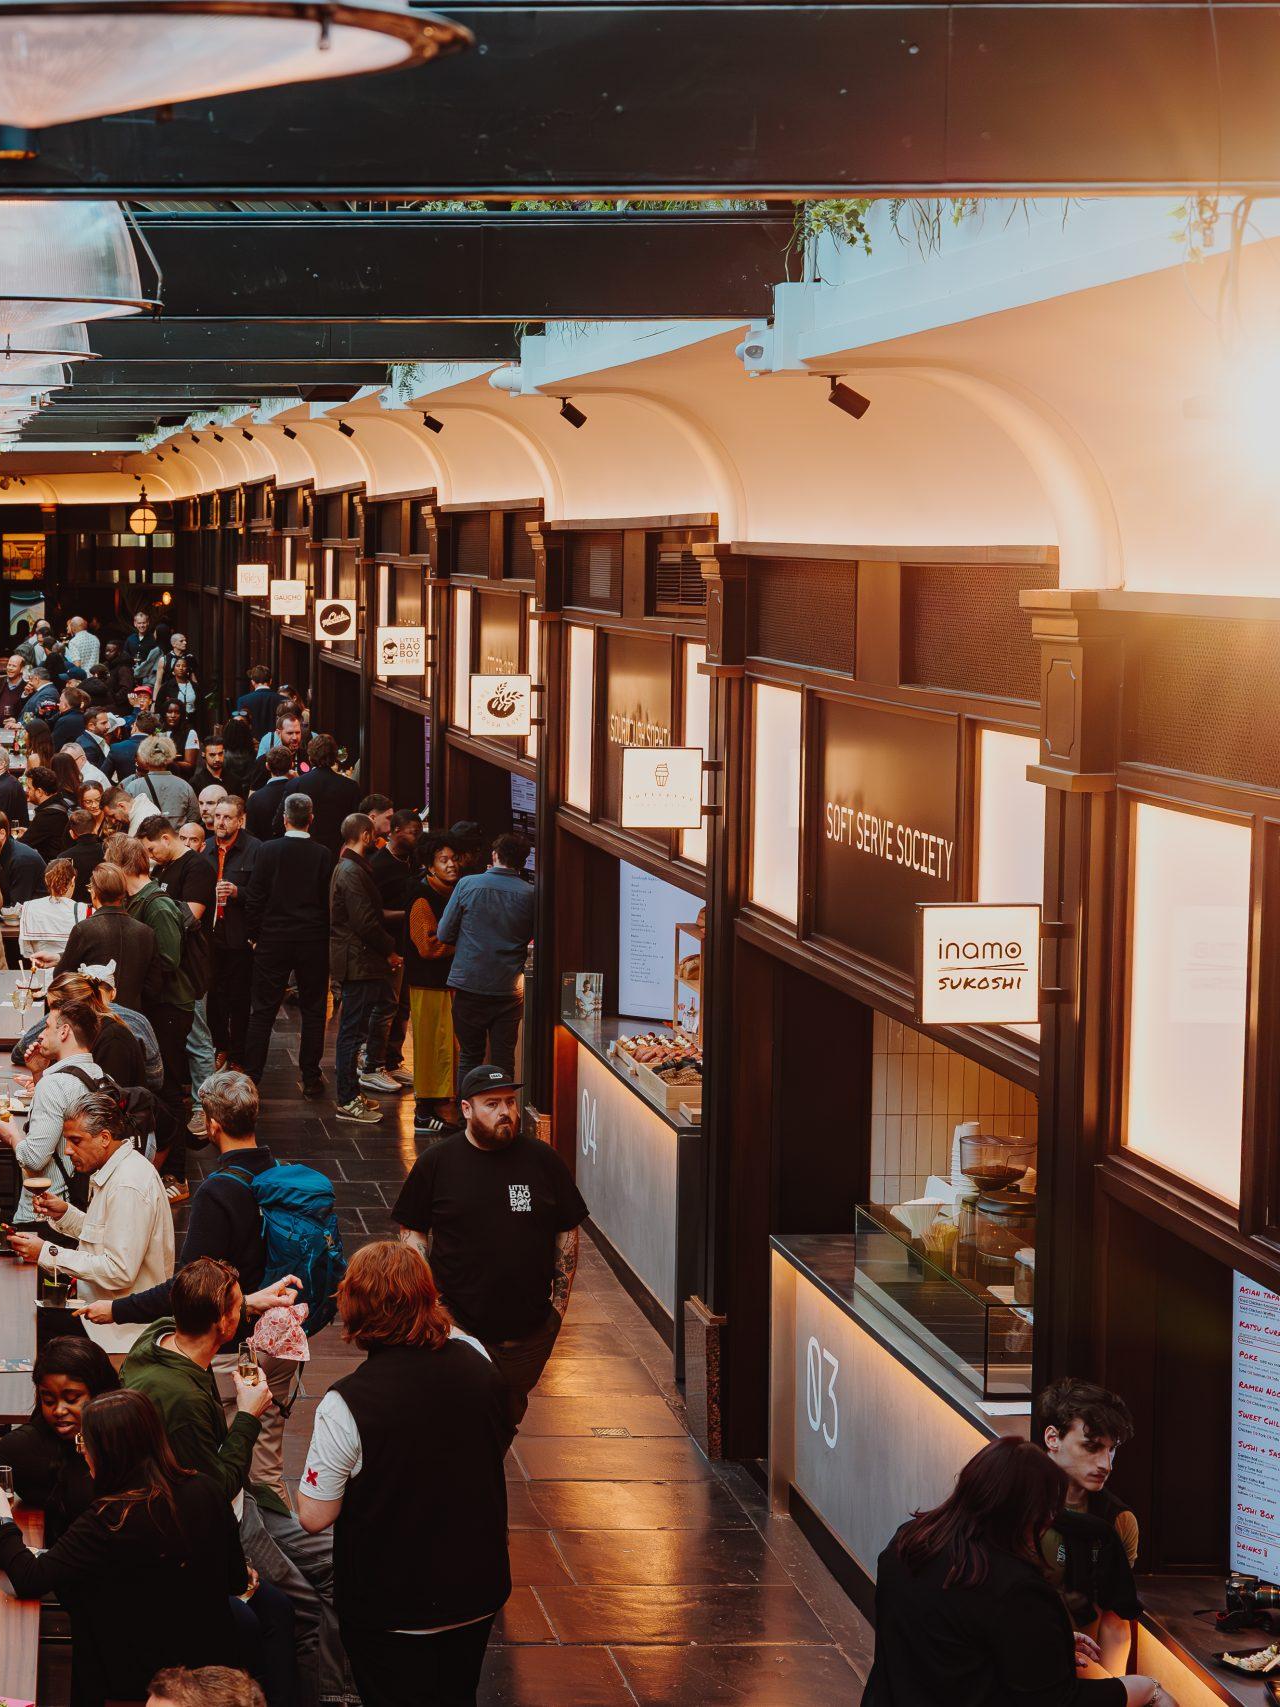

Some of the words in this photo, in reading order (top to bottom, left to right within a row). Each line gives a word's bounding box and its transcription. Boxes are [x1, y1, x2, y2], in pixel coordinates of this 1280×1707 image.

[399, 650, 421, 658] BOY
[826, 802, 854, 846] SOFT
[856, 811, 894, 861] SERVE
[896, 824, 954, 882] SOCIETY
[938, 938, 1022, 960] inamo
[938, 976, 1022, 991] SUKOSHI
[581, 1088, 597, 1165] 04
[509, 1190, 531, 1199] BAO
[510, 1198, 532, 1207] BOY
[1239, 1286, 1261, 1297] ASIAN
[1239, 1321, 1262, 1332] KATSU
[1239, 1350, 1259, 1362] POKE
[807, 1336, 839, 1449] 03
[1238, 1381, 1264, 1394] RAMEN
[1238, 1410, 1262, 1422] SWEET
[1237, 1440, 1258, 1453] SUSHI
[1236, 1503, 1257, 1516] SUSHI
[1259, 1510, 1275, 1521] BOX
[1236, 1541, 1263, 1555] DRINKS
